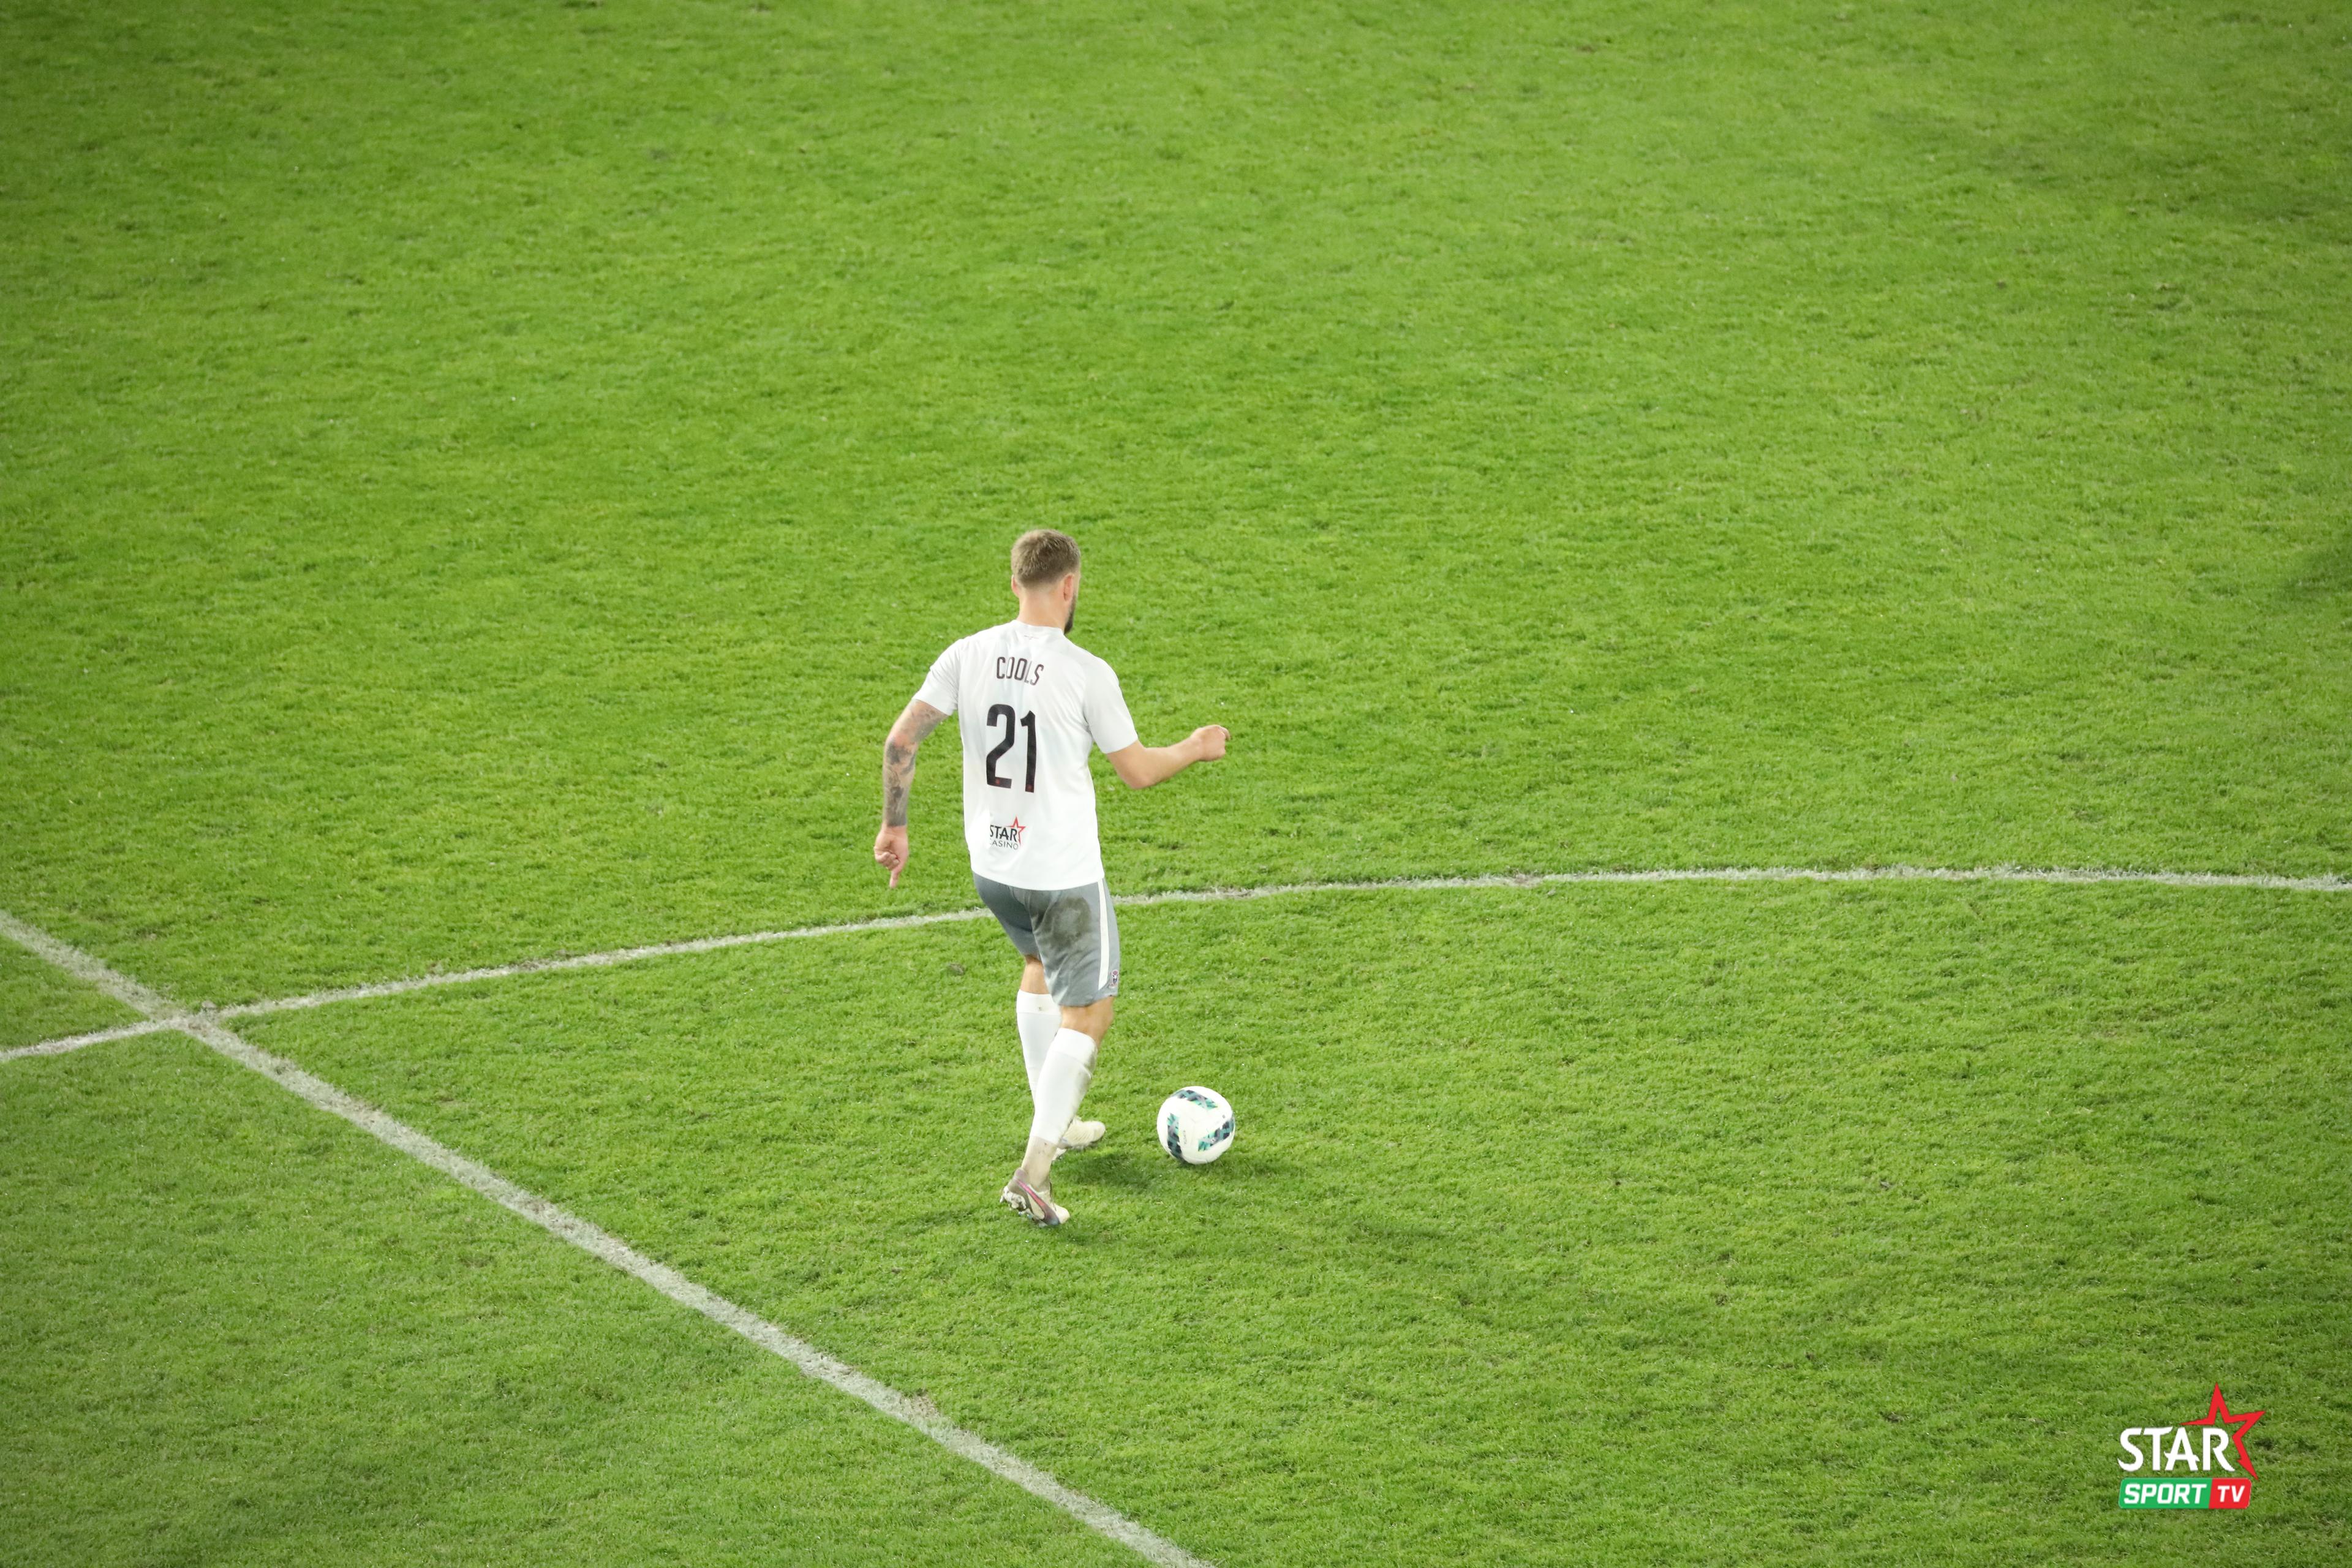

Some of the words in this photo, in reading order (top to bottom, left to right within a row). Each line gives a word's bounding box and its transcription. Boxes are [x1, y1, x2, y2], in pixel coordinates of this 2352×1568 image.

[997, 657, 1044, 686] COOLS
[986, 704, 1037, 793] 21
[990, 824, 1017, 842] STAR
[990, 838, 1019, 850] ASINO
